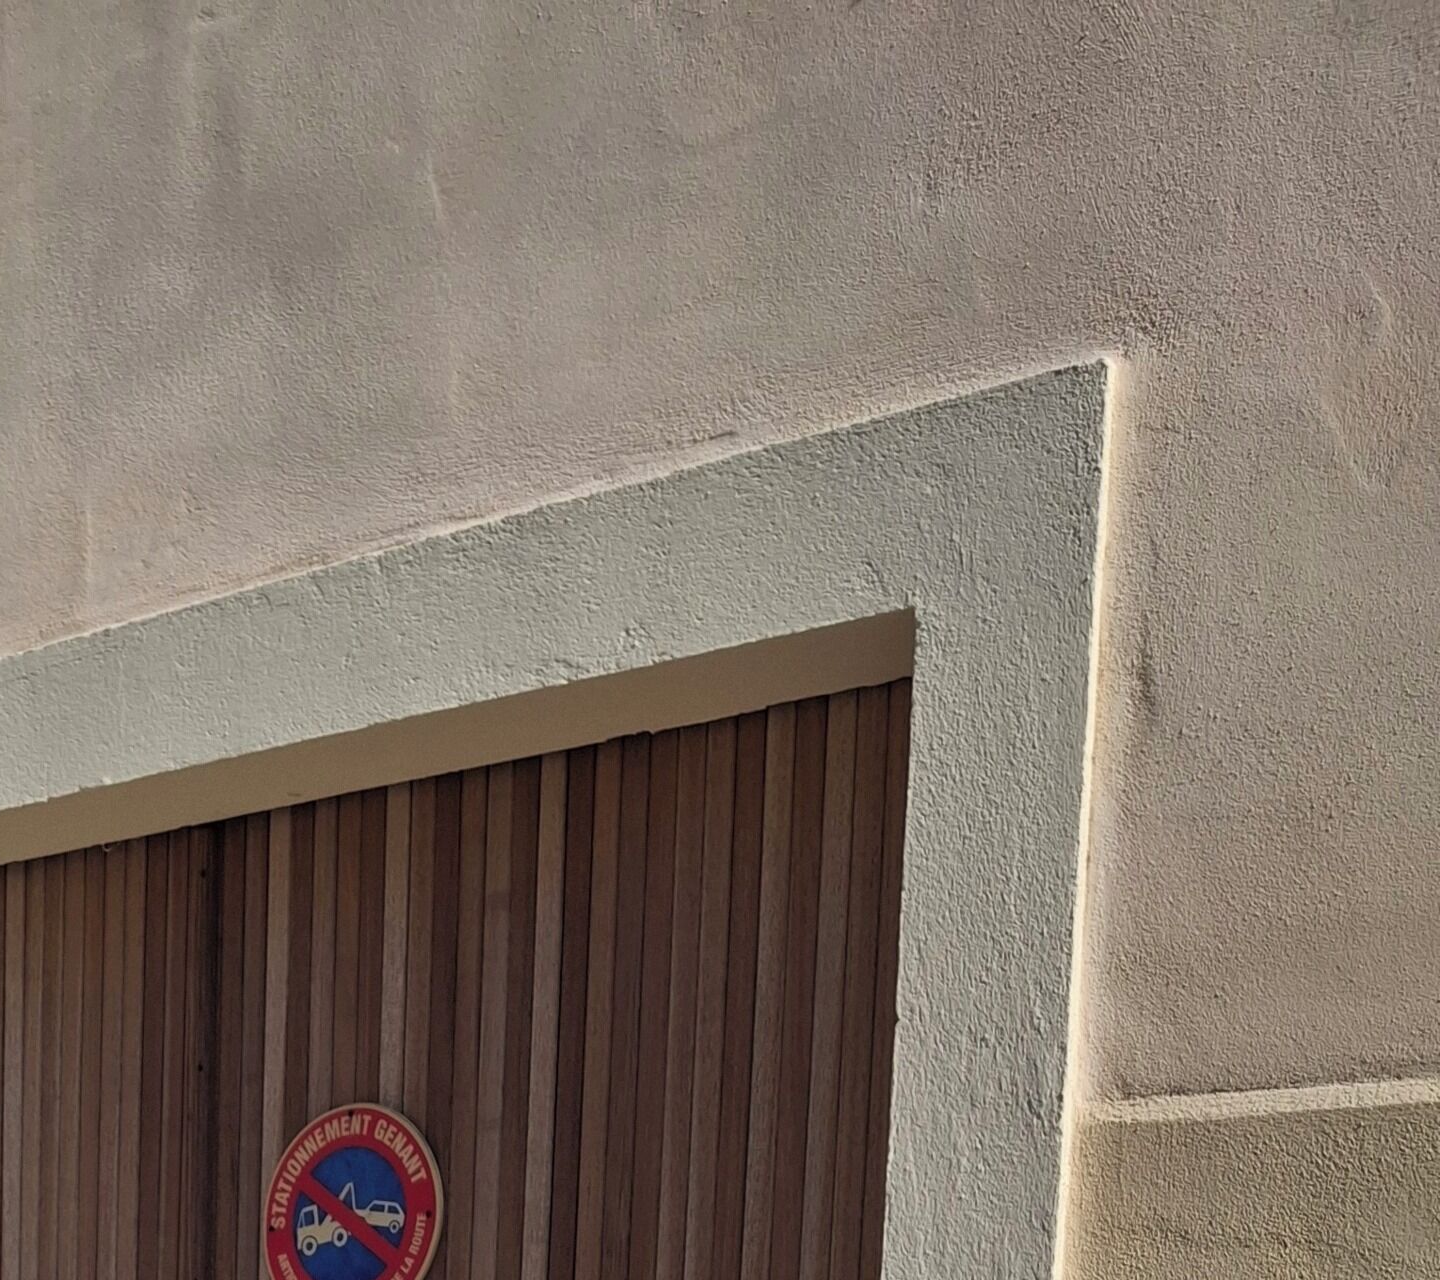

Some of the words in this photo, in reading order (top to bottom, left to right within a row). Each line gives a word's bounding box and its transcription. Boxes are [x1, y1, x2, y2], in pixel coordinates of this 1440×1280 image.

[271, 1113, 372, 1229] STATIONNEMENT
[374, 1119, 427, 1183] GENANT
[400, 1256, 415, 1274] LA
[408, 1212, 427, 1255] ROUTE
